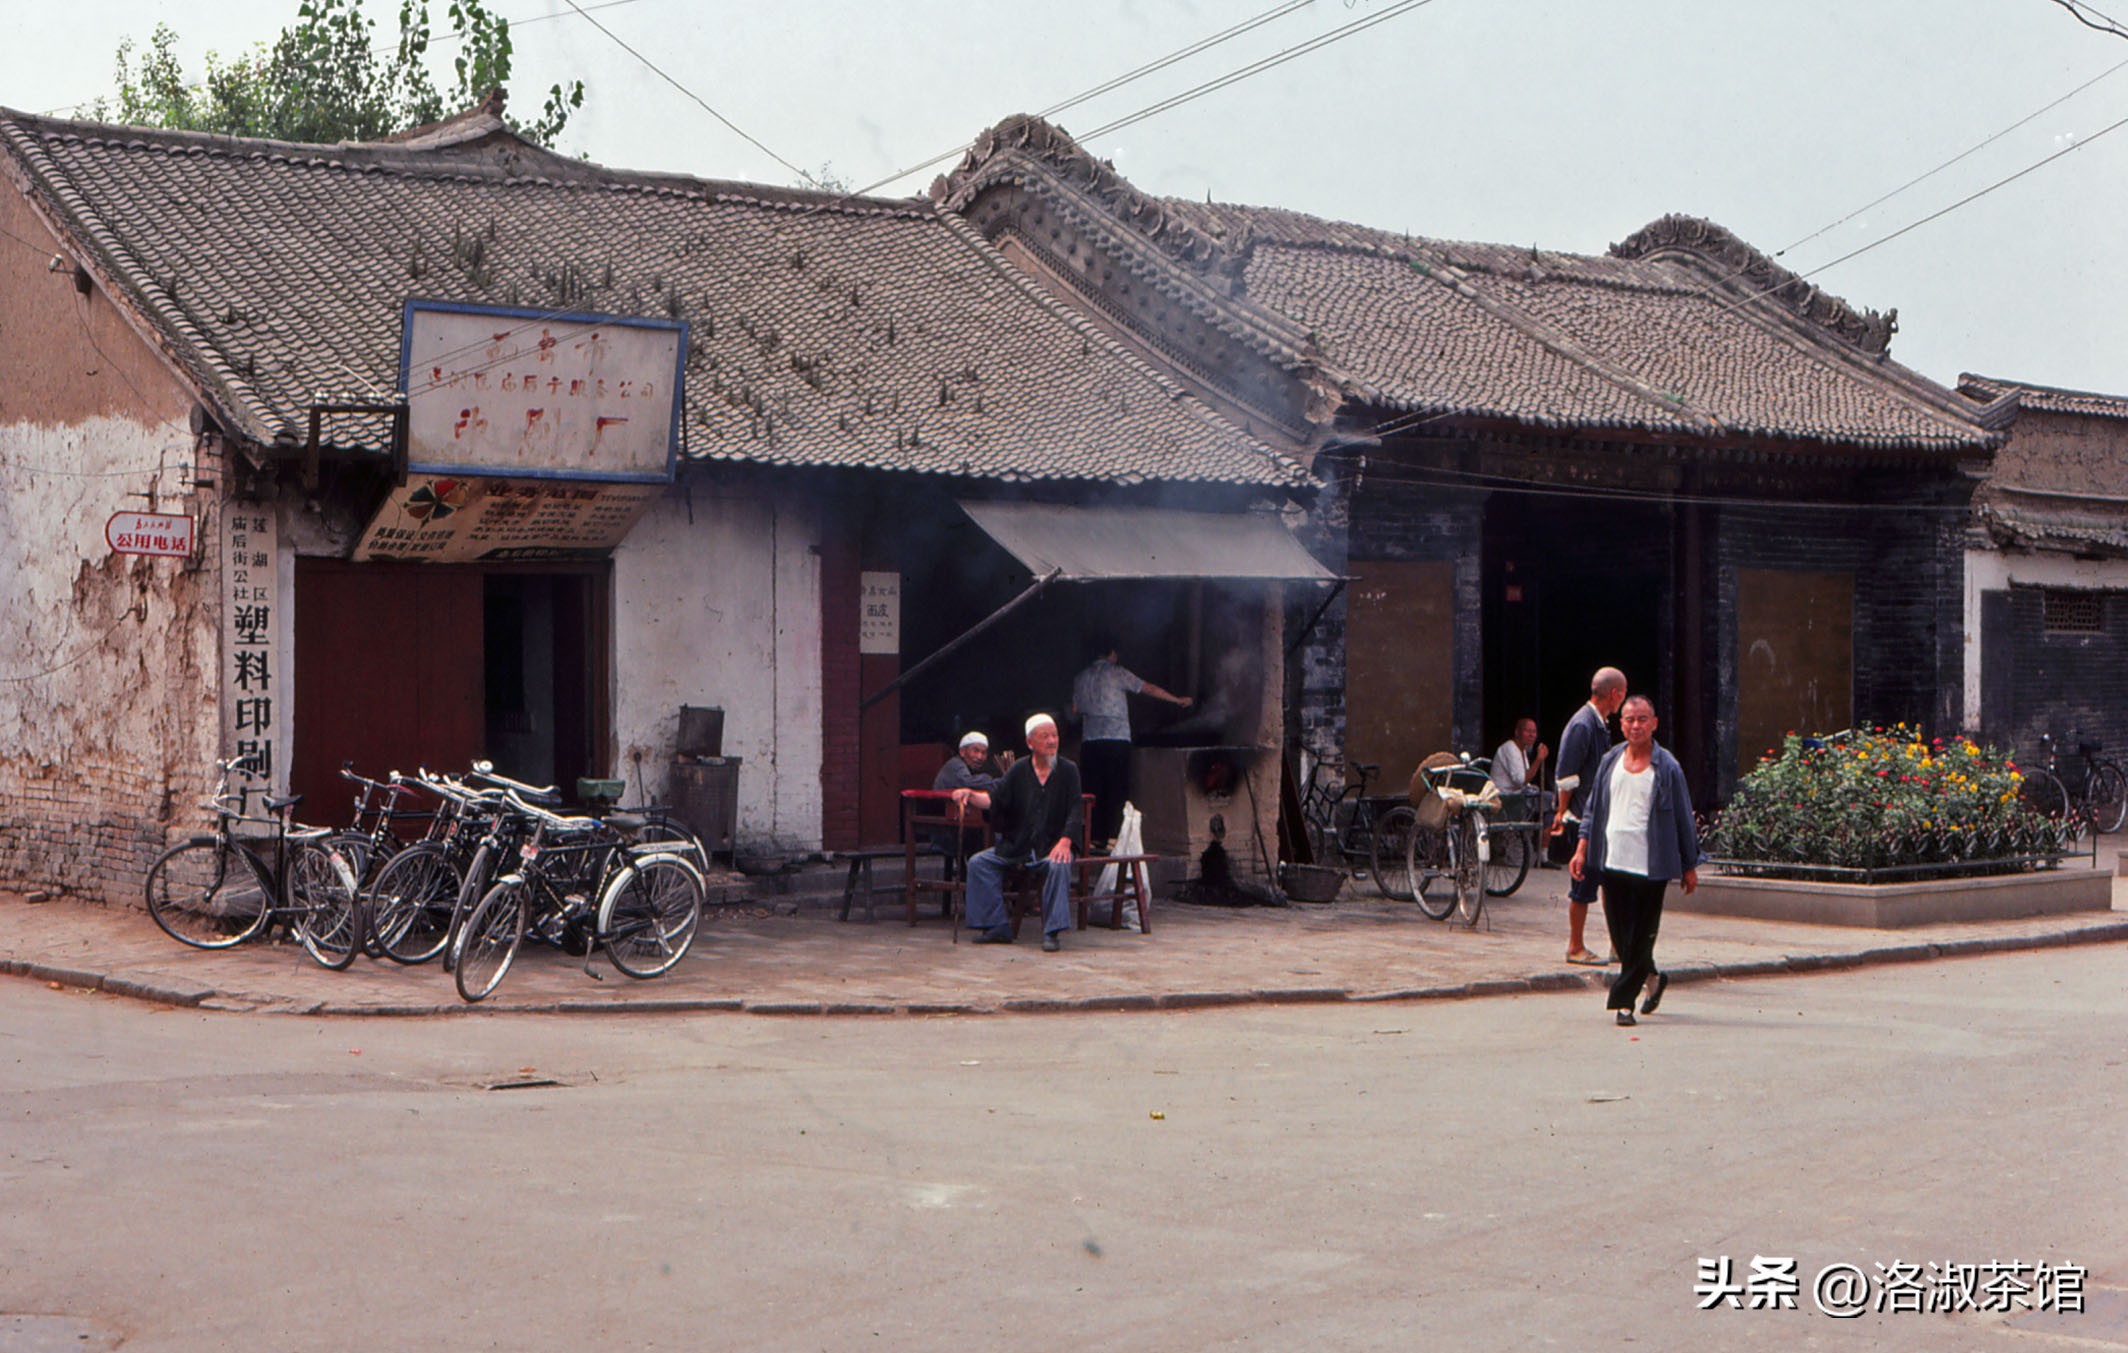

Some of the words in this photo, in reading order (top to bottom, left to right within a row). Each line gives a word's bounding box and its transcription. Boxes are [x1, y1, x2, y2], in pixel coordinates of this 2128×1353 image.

[117, 533, 187, 551] 公用电话
[232, 515, 248, 601] 庙后街公社
[252, 516, 269, 601] 莲湖区
[233, 604, 273, 824] 塑料印刷厂
